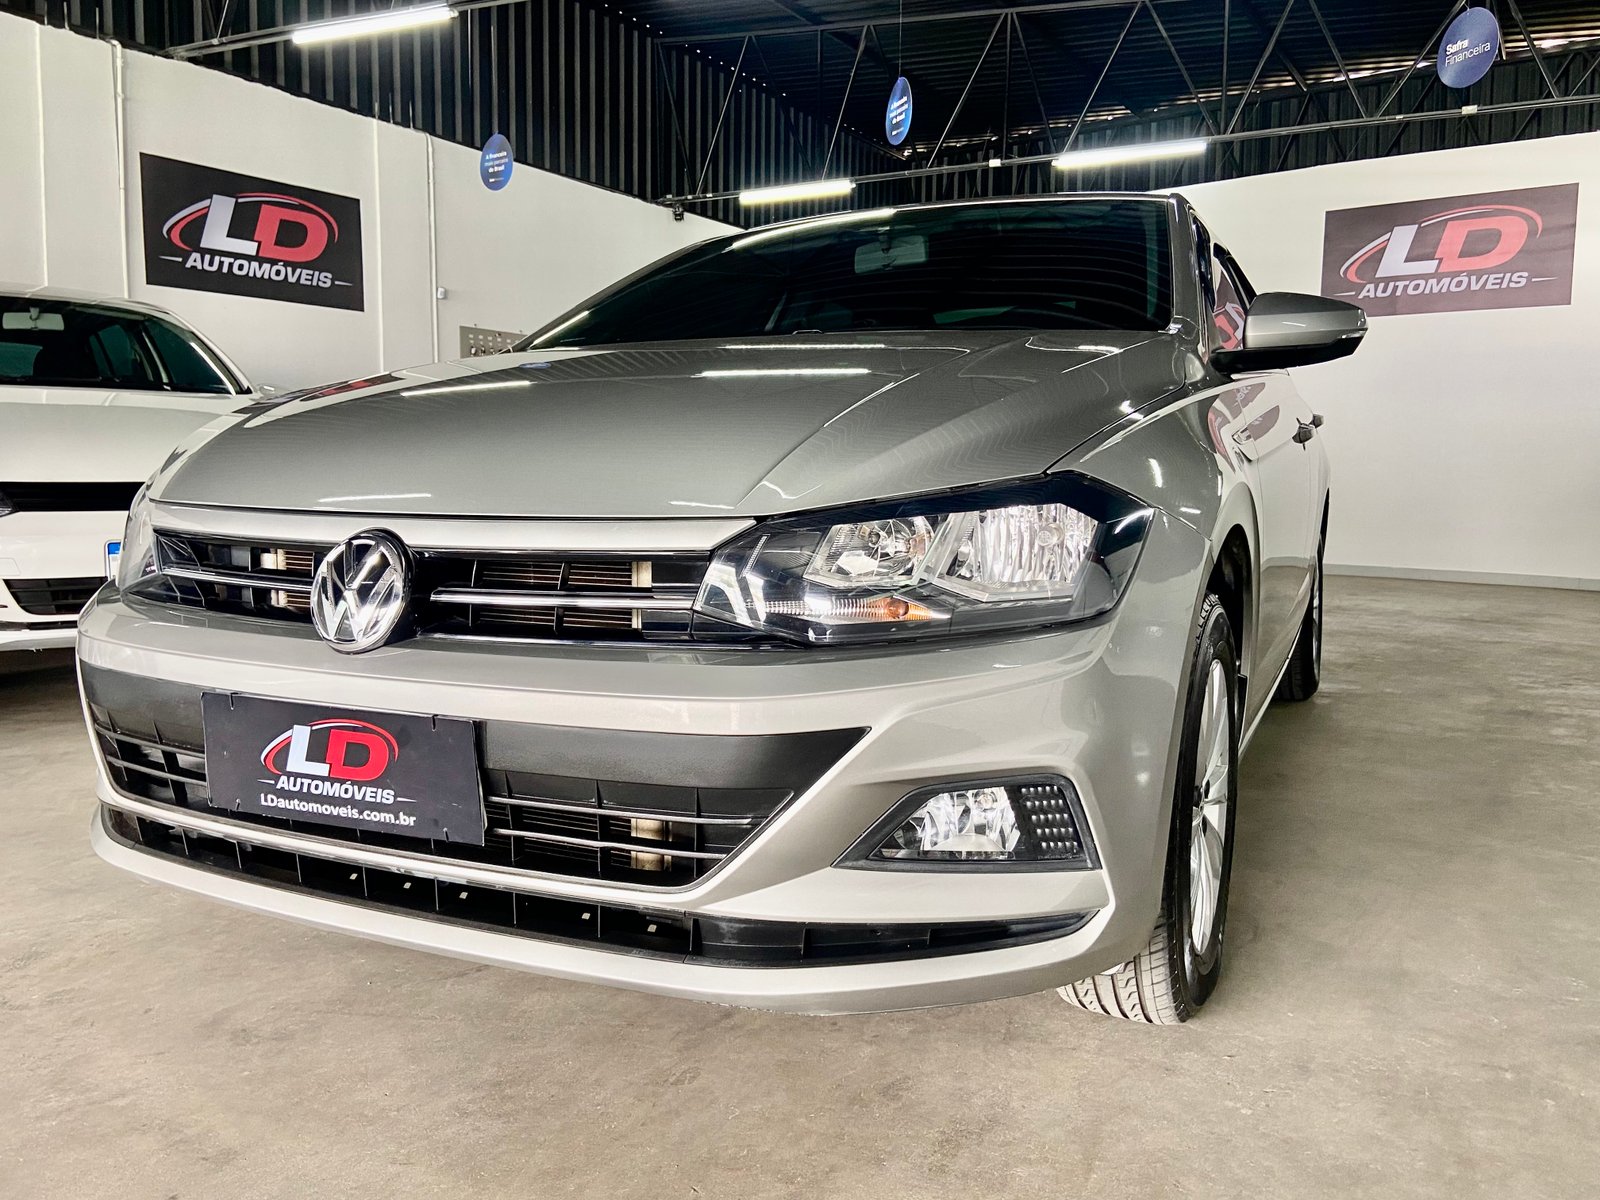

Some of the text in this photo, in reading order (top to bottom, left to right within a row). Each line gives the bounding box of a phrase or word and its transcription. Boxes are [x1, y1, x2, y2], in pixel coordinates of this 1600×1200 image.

[1445, 42, 1491, 67] Financeira
[1446, 39, 1469, 55] Safra
[200, 194, 329, 263] LD
[1375, 215, 1529, 278] LD
[185, 252, 333, 288] AUTOMÓVEIS
[1357, 271, 1529, 299] AUTOMÓVEIS
[286, 724, 389, 781] LD
[276, 776, 395, 804] AUTOMÓVEIS
[260, 793, 417, 826] LDautomoveis.com.br
